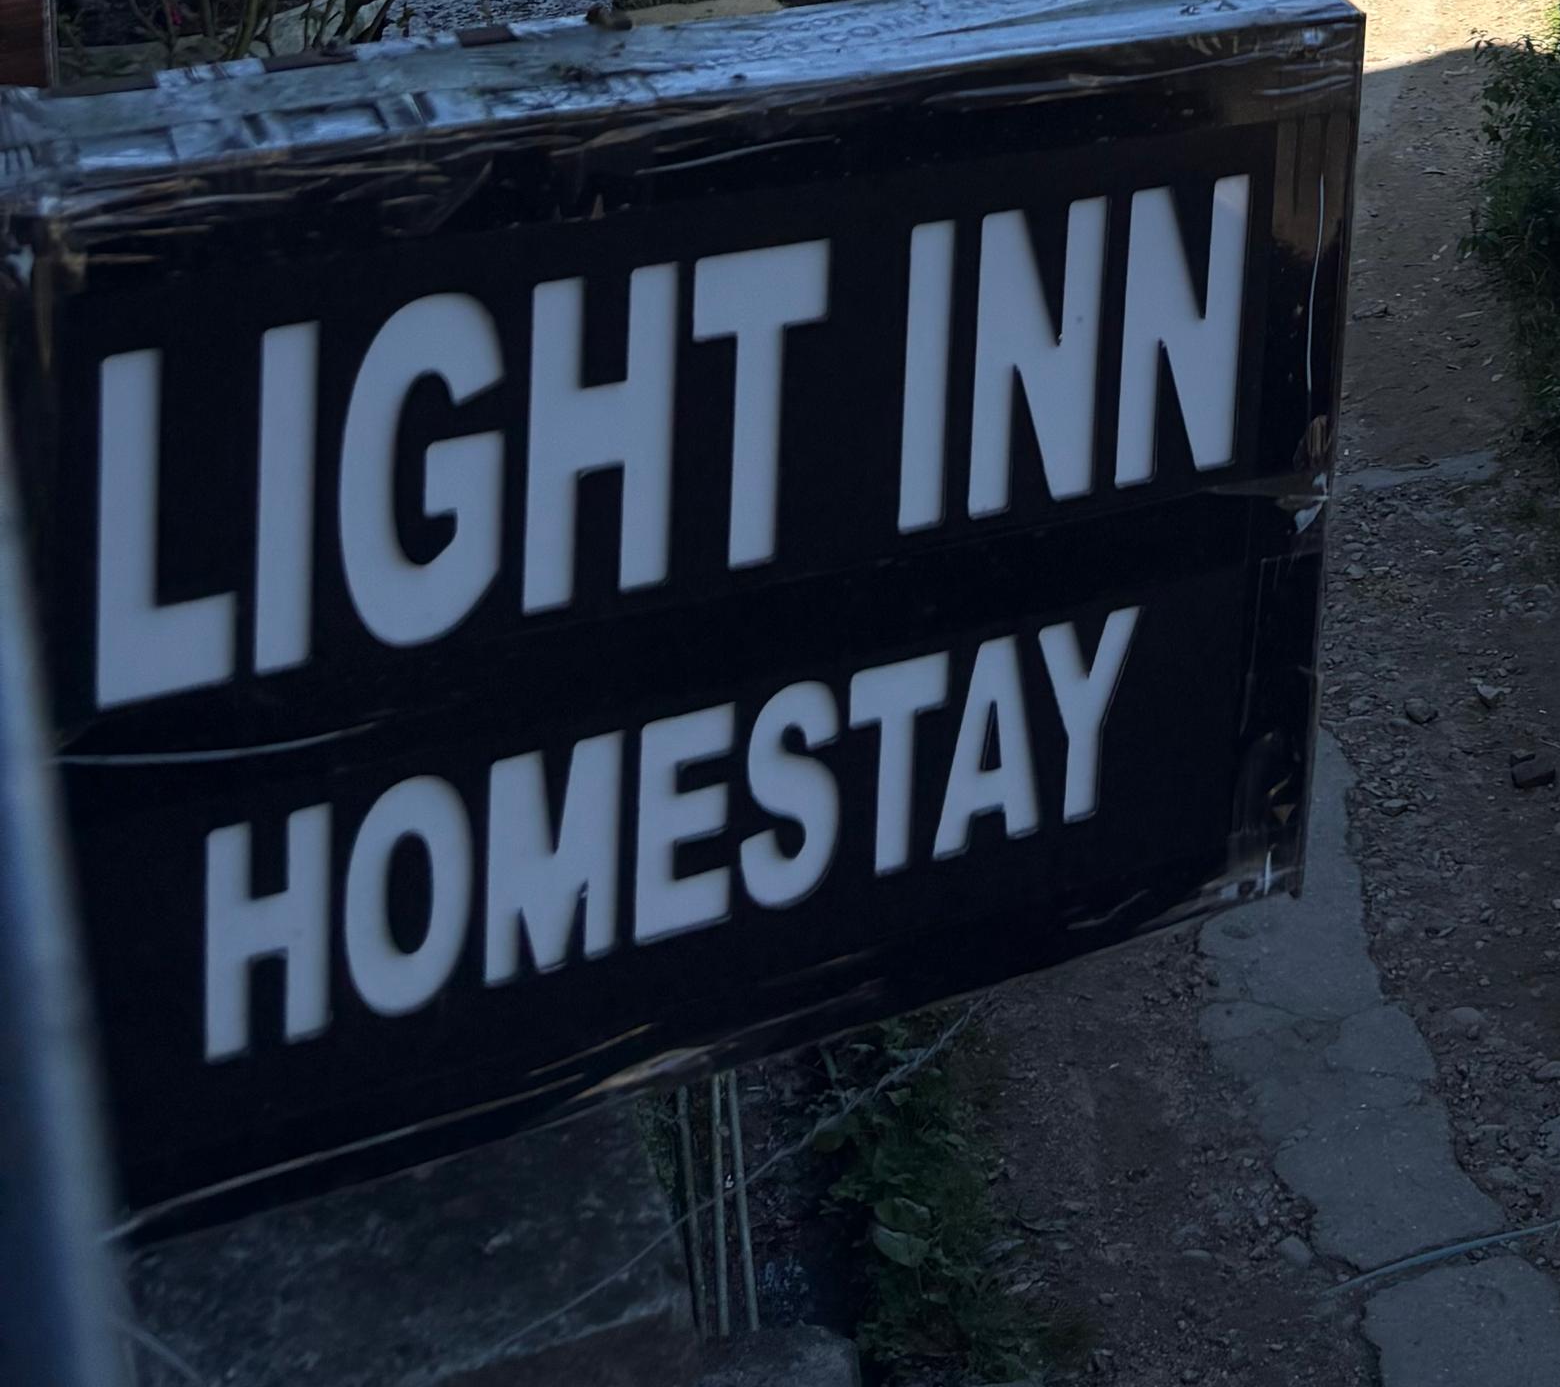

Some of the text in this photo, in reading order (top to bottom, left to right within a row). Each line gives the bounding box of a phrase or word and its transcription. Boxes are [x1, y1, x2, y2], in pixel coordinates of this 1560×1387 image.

[95, 173, 1251, 712] LIGHT INN
[203, 605, 1142, 1065] HOMESTAY
